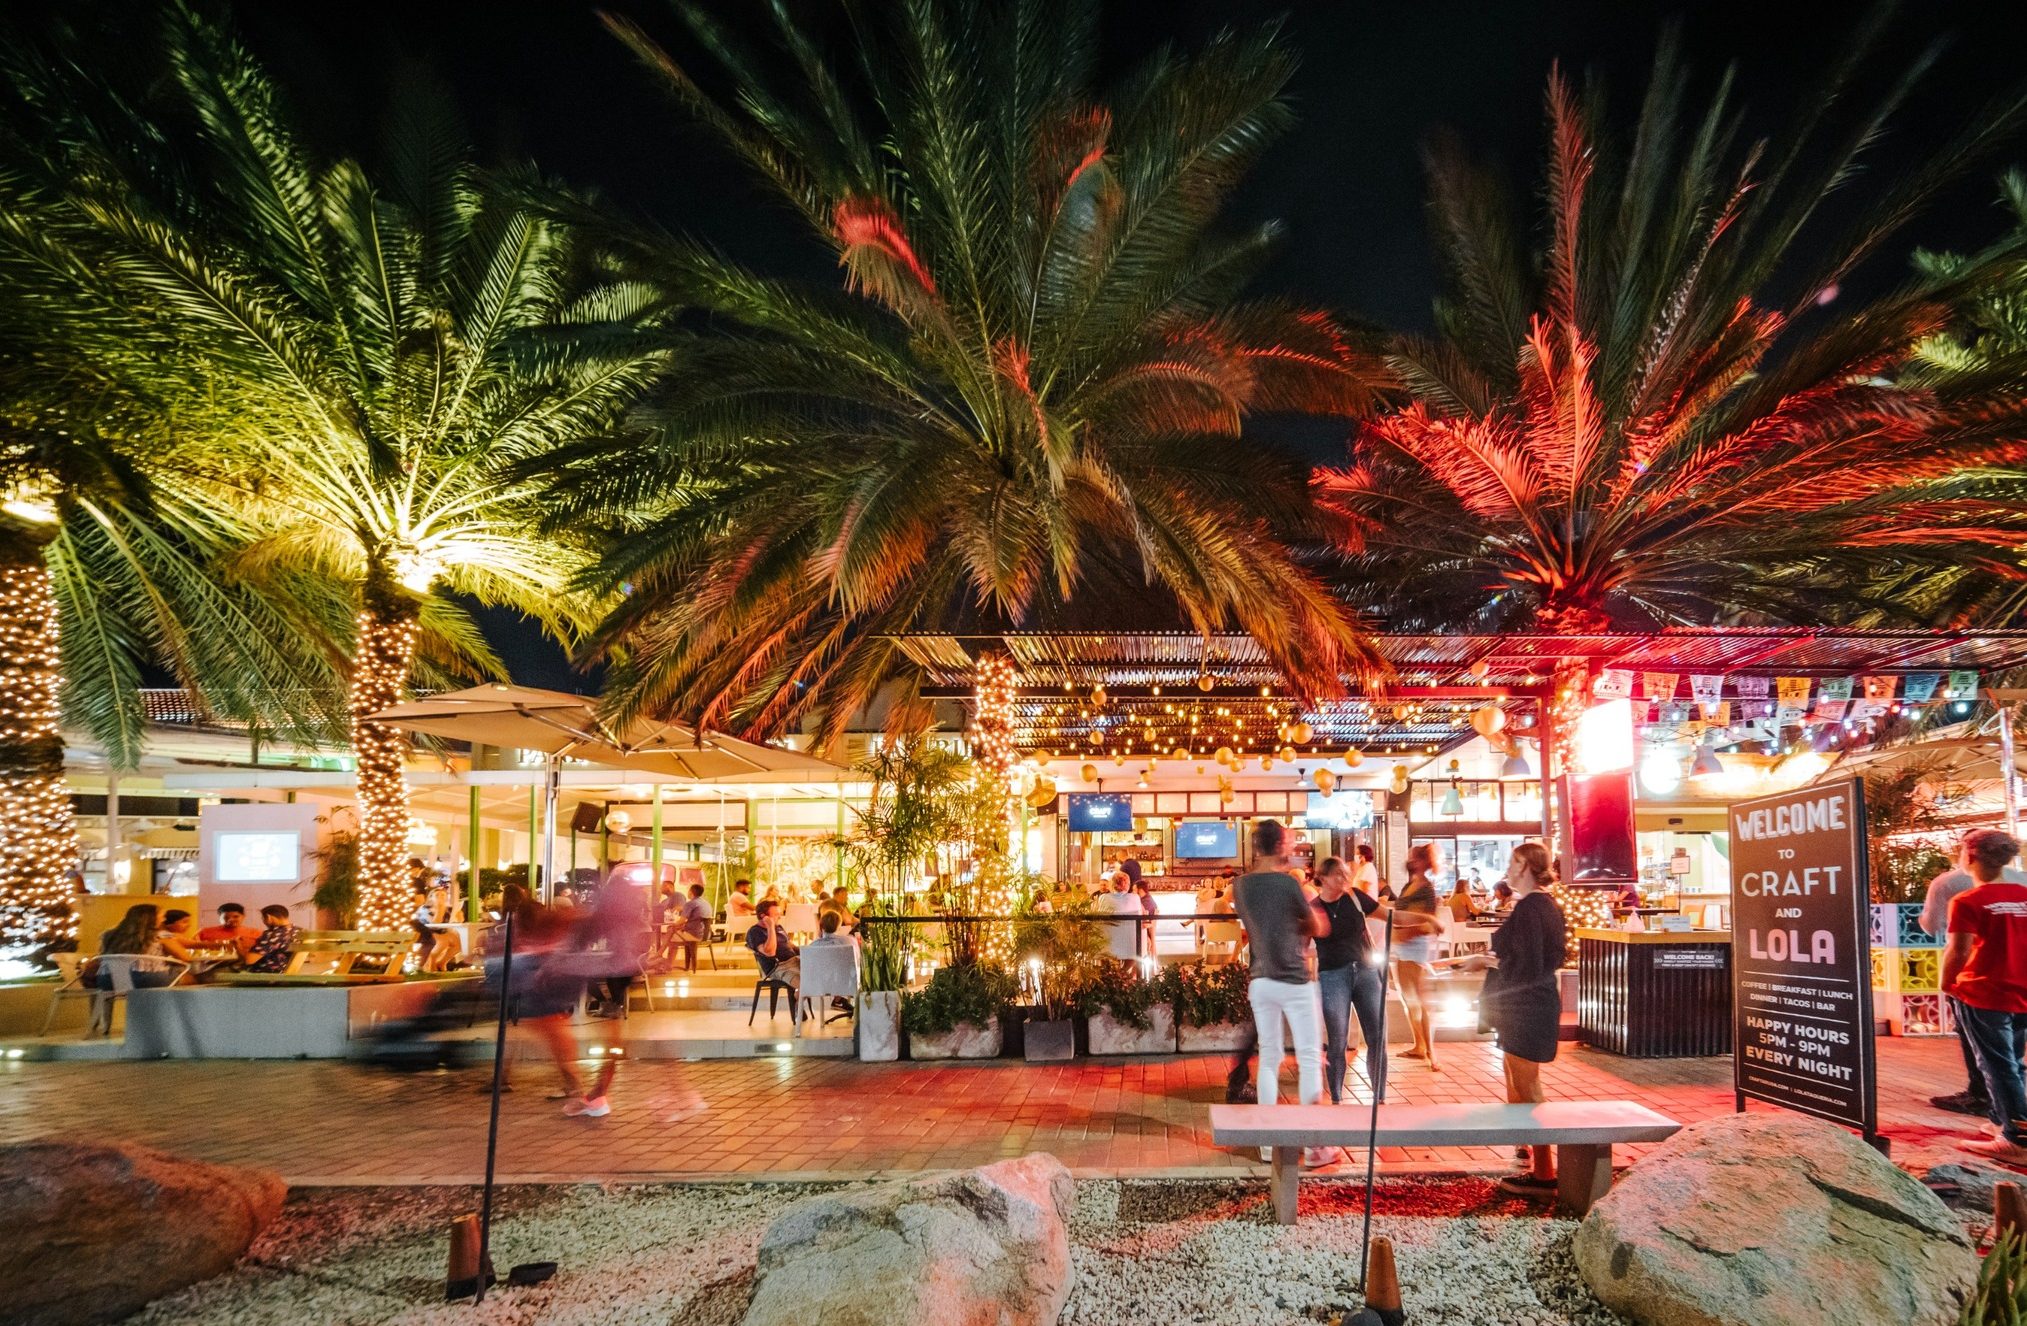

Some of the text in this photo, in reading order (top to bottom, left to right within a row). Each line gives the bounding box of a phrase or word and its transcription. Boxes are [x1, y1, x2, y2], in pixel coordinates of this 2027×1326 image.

[1735, 795, 1847, 842] WELCOME
[1777, 848, 1796, 860] TO
[1741, 865, 1842, 897] CRAFT
[1775, 907, 1803, 918] AND
[1749, 928, 1836, 965] LOLA
[1741, 980, 1767, 990] COFFEE
[1771, 984, 1817, 996] BREAKFAST
[1822, 990, 1853, 1001] LUNCH
[1750, 993, 1778, 1004] DINNER
[1782, 997, 1811, 1008] TACOS
[1816, 1002, 1836, 1012] BAR
[1746, 1015, 1850, 1045] HAPPY HOURS
[1759, 1032, 1787, 1048] 5PM
[1799, 1041, 1831, 1058] 9PM
[1746, 1045, 1853, 1081] EVERY NIGHT
